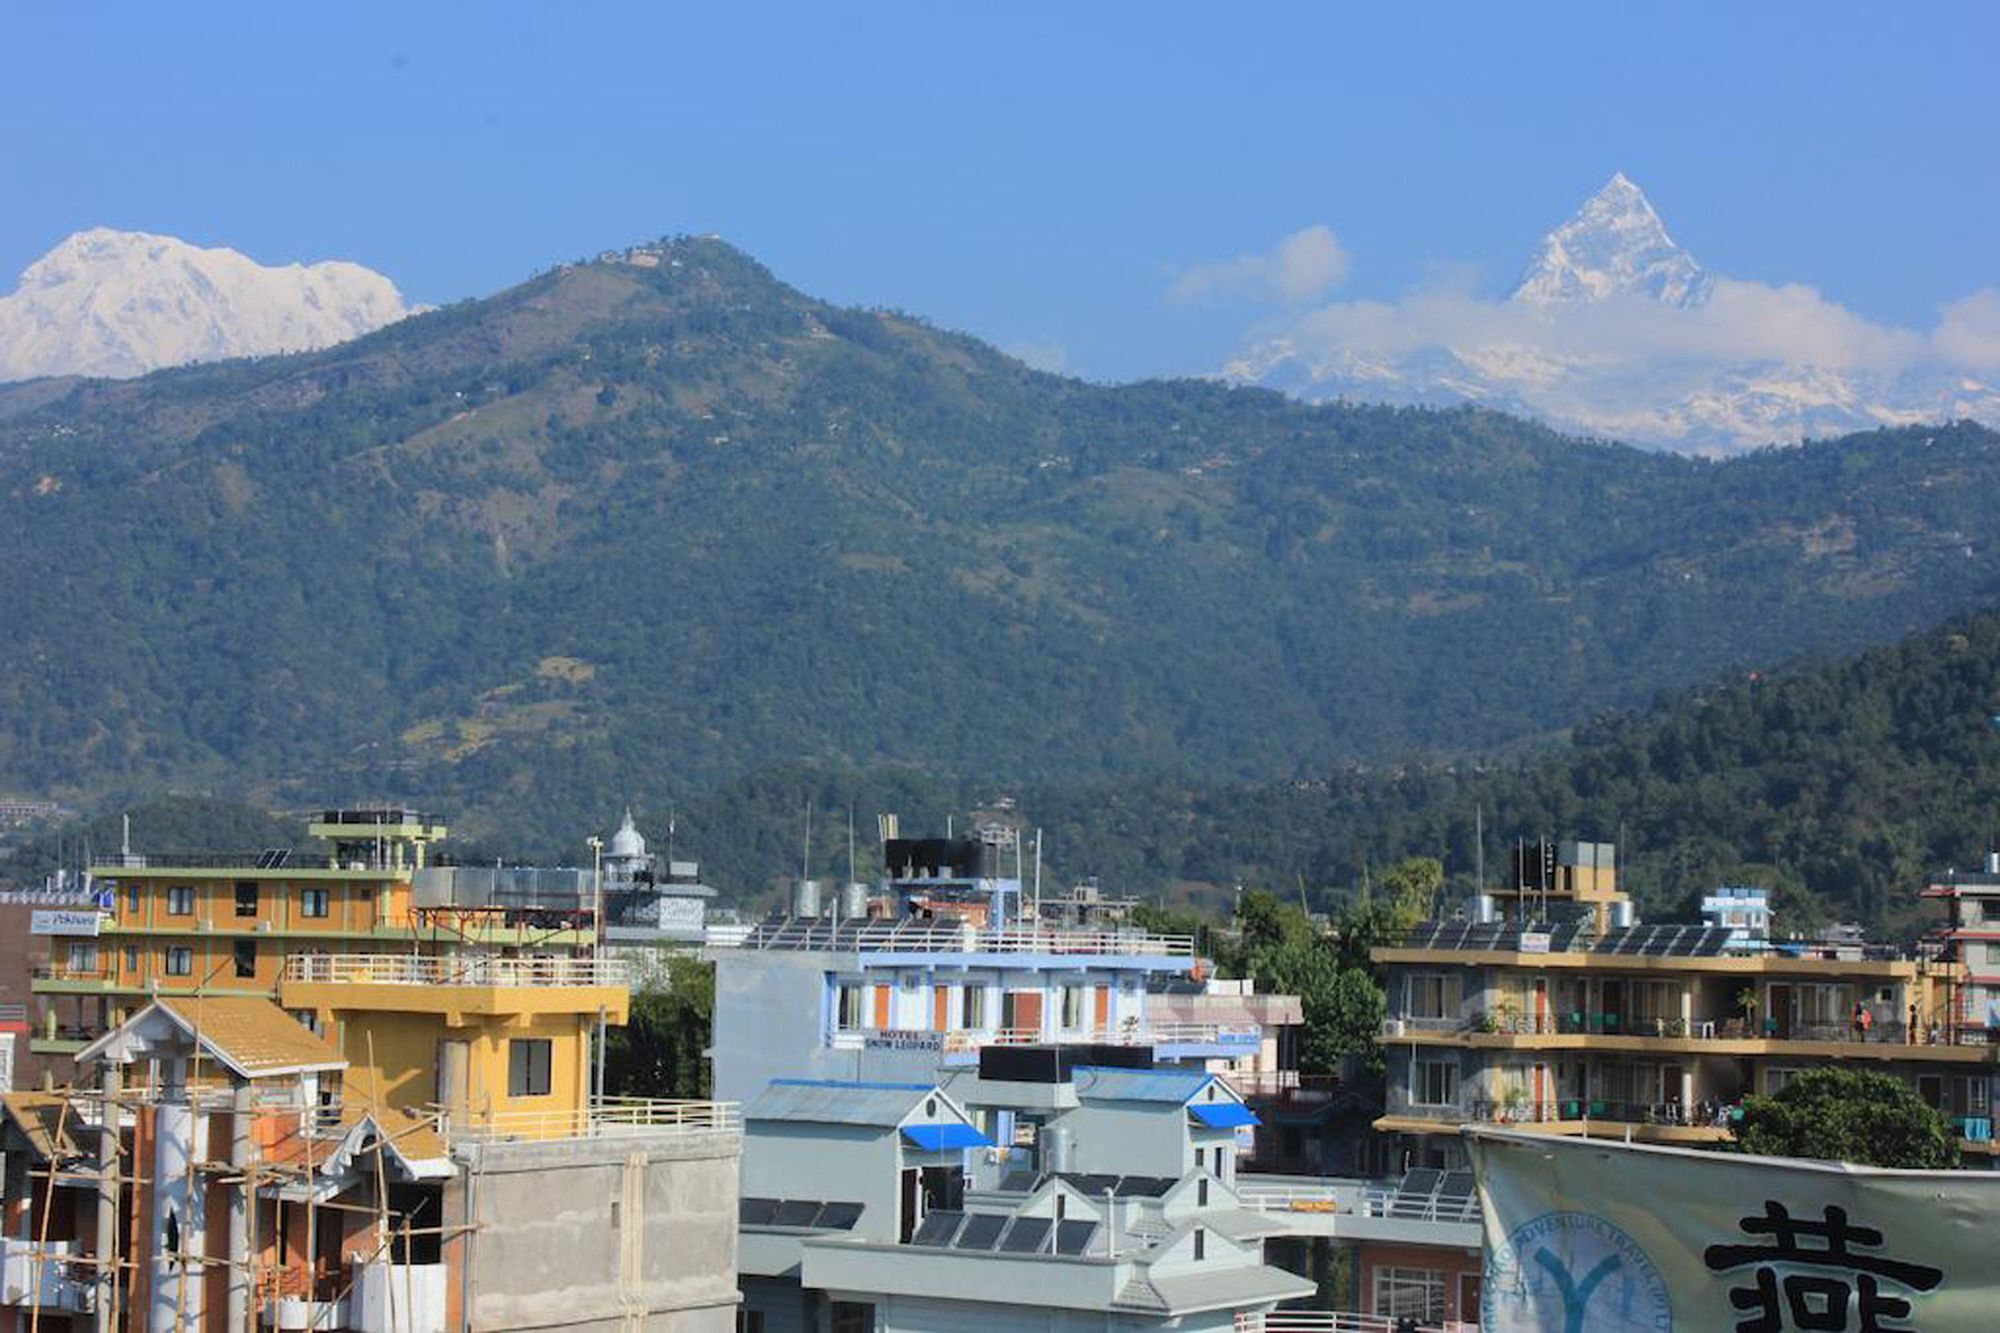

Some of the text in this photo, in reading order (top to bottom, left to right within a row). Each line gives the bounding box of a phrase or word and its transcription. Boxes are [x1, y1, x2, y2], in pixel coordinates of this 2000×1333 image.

[880, 1030, 920, 1040] HOTEL
[895, 1039, 941, 1051] LEOPARD
[1513, 1214, 1606, 1250] ADVENTURE
